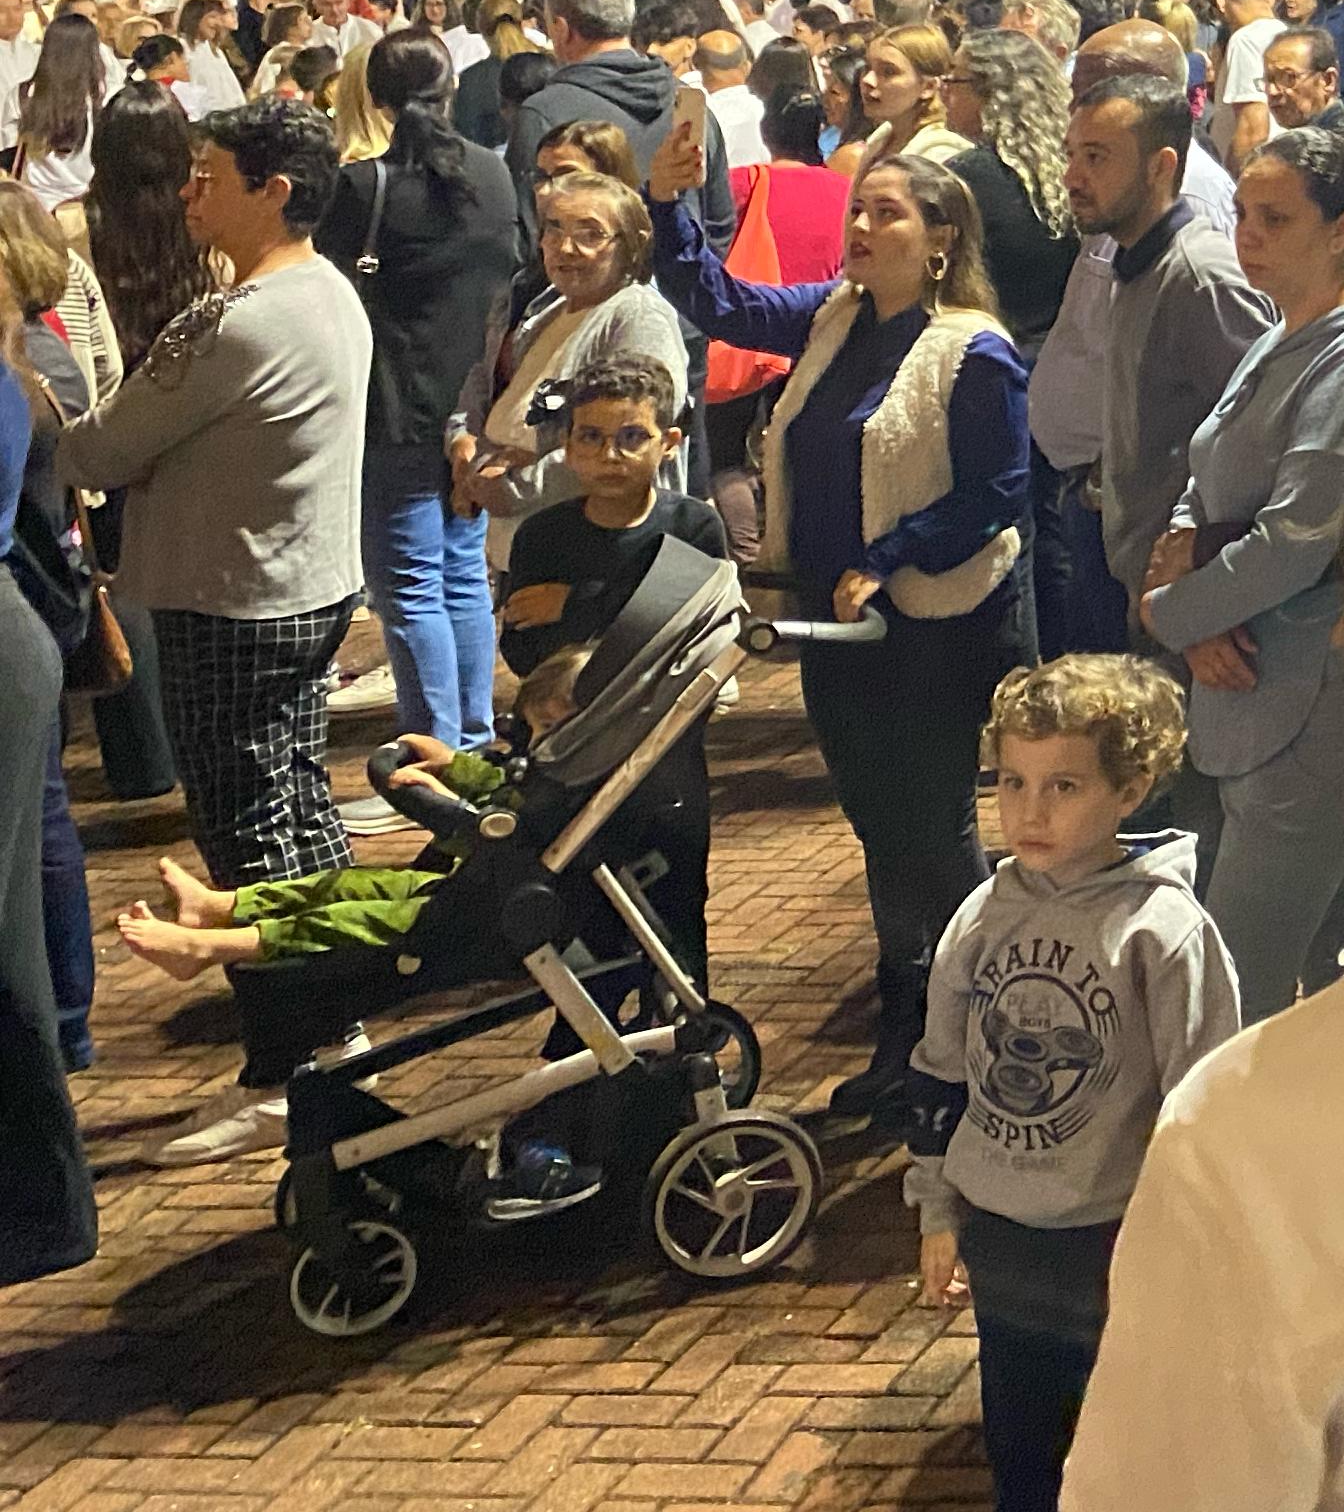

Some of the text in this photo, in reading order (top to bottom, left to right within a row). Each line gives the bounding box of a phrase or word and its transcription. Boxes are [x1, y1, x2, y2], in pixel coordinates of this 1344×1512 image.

[972, 938, 1116, 1016] TRAIN TO
[983, 1112, 1062, 1151] SPIN
